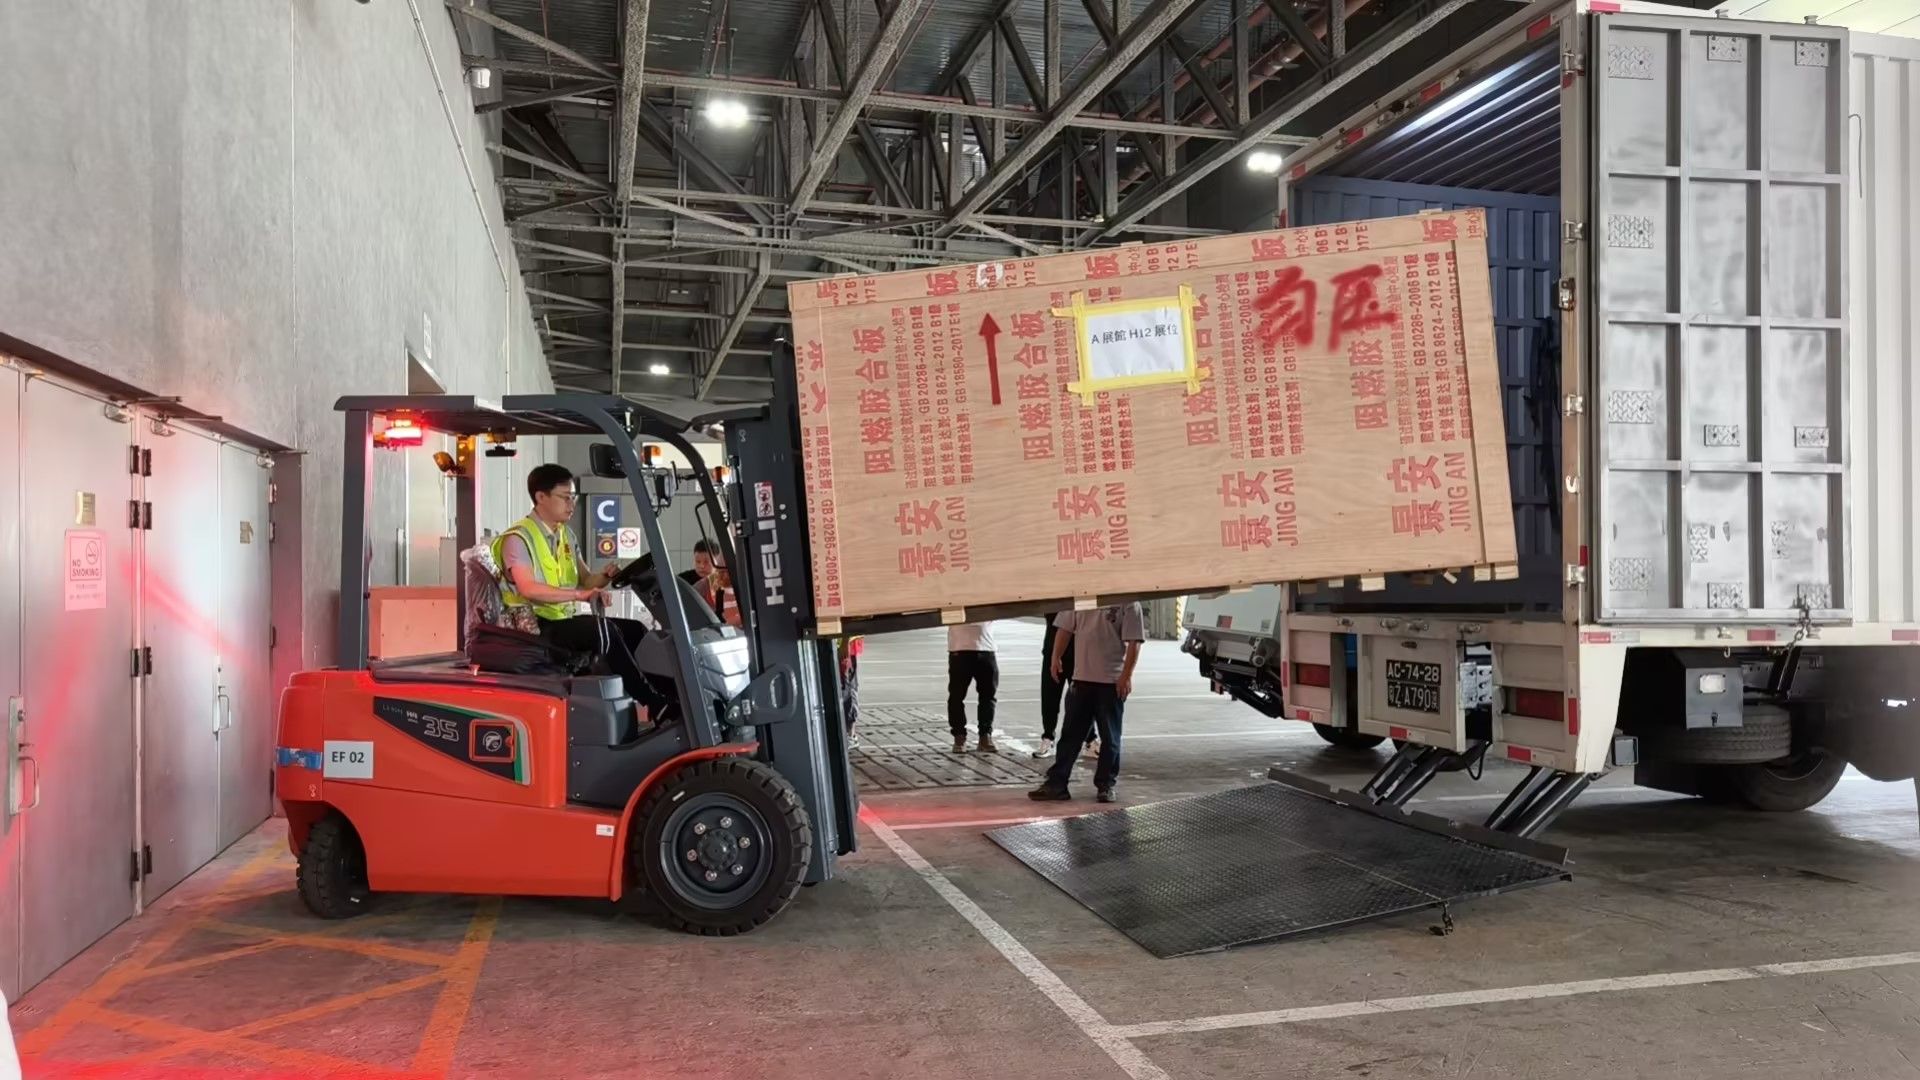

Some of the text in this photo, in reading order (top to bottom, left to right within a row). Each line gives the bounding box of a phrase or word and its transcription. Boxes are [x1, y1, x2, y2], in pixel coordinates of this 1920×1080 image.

[1186, 241, 1197, 250] E
[1314, 227, 1327, 237] B
[1335, 225, 1347, 235] B
[1356, 223, 1367, 232] E
[845, 279, 856, 288] B
[1408, 281, 1425, 347] 20286-2006
[1429, 280, 1446, 346] 8624-2012
[913, 331, 928, 395] 20286-2006
[931, 331, 947, 395] 8624-2012
[951, 328, 965, 385] 18580-2017
[1091, 334, 1100, 344] A
[1129, 327, 1152, 339] H12
[1239, 299, 1255, 364] 20286-2006
[853, 327, 896, 474] 阻燃胶合板
[1010, 310, 1055, 460] 阻燃胶合板
[597, 499, 615, 522] C
[1105, 482, 1131, 560] JING AN
[1217, 471, 1273, 551] 景安
[1272, 468, 1299, 547] JING AN
[1386, 455, 1444, 537] 景安
[1443, 452, 1472, 531] JING AN
[894, 499, 946, 577] 景安
[945, 496, 970, 573] JING AN
[1052, 485, 1106, 564] 景安
[72, 559, 81, 567] NO
[72, 568, 100, 577] SMOKING
[758, 519, 784, 606] HELI
[1388, 662, 1440, 682] AC-74-28
[331, 751, 365, 763] EF 02
[422, 715, 459, 742] 35
